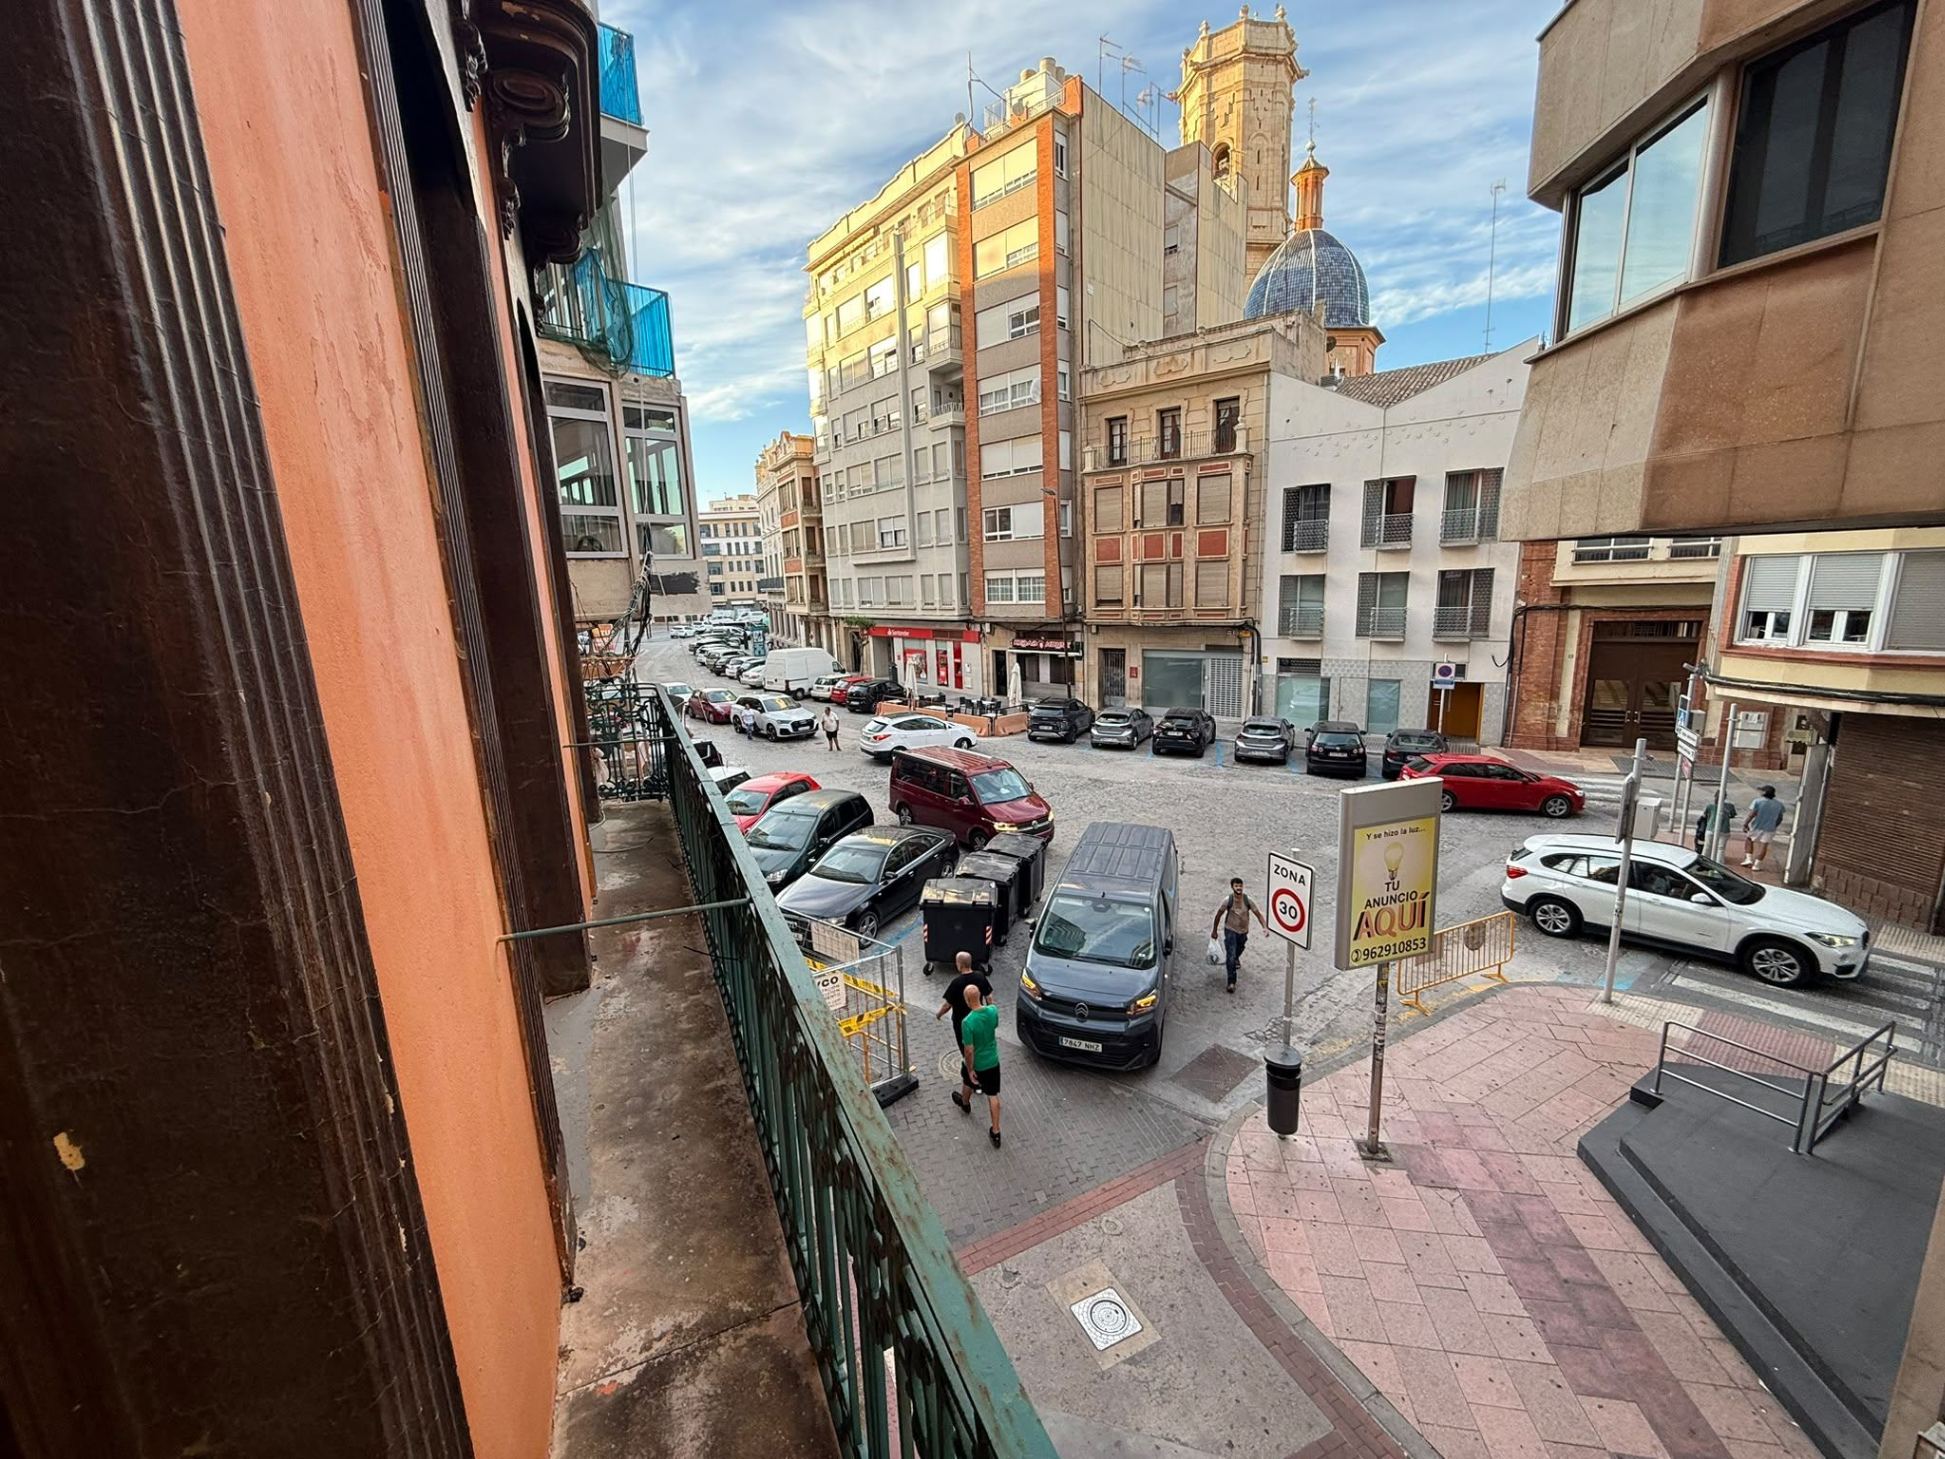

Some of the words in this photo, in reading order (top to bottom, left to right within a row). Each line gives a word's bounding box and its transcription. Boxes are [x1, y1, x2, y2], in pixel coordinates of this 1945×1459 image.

[1384, 829, 1399, 837] hizo
[1274, 864, 1306, 886] ZONA
[1384, 880, 1400, 892] TU
[1364, 890, 1418, 909] ANUNCIO
[1279, 901, 1298, 920] 30
[1353, 891, 1430, 941] AQUÍ
[1362, 937, 1426, 961] 962910853
